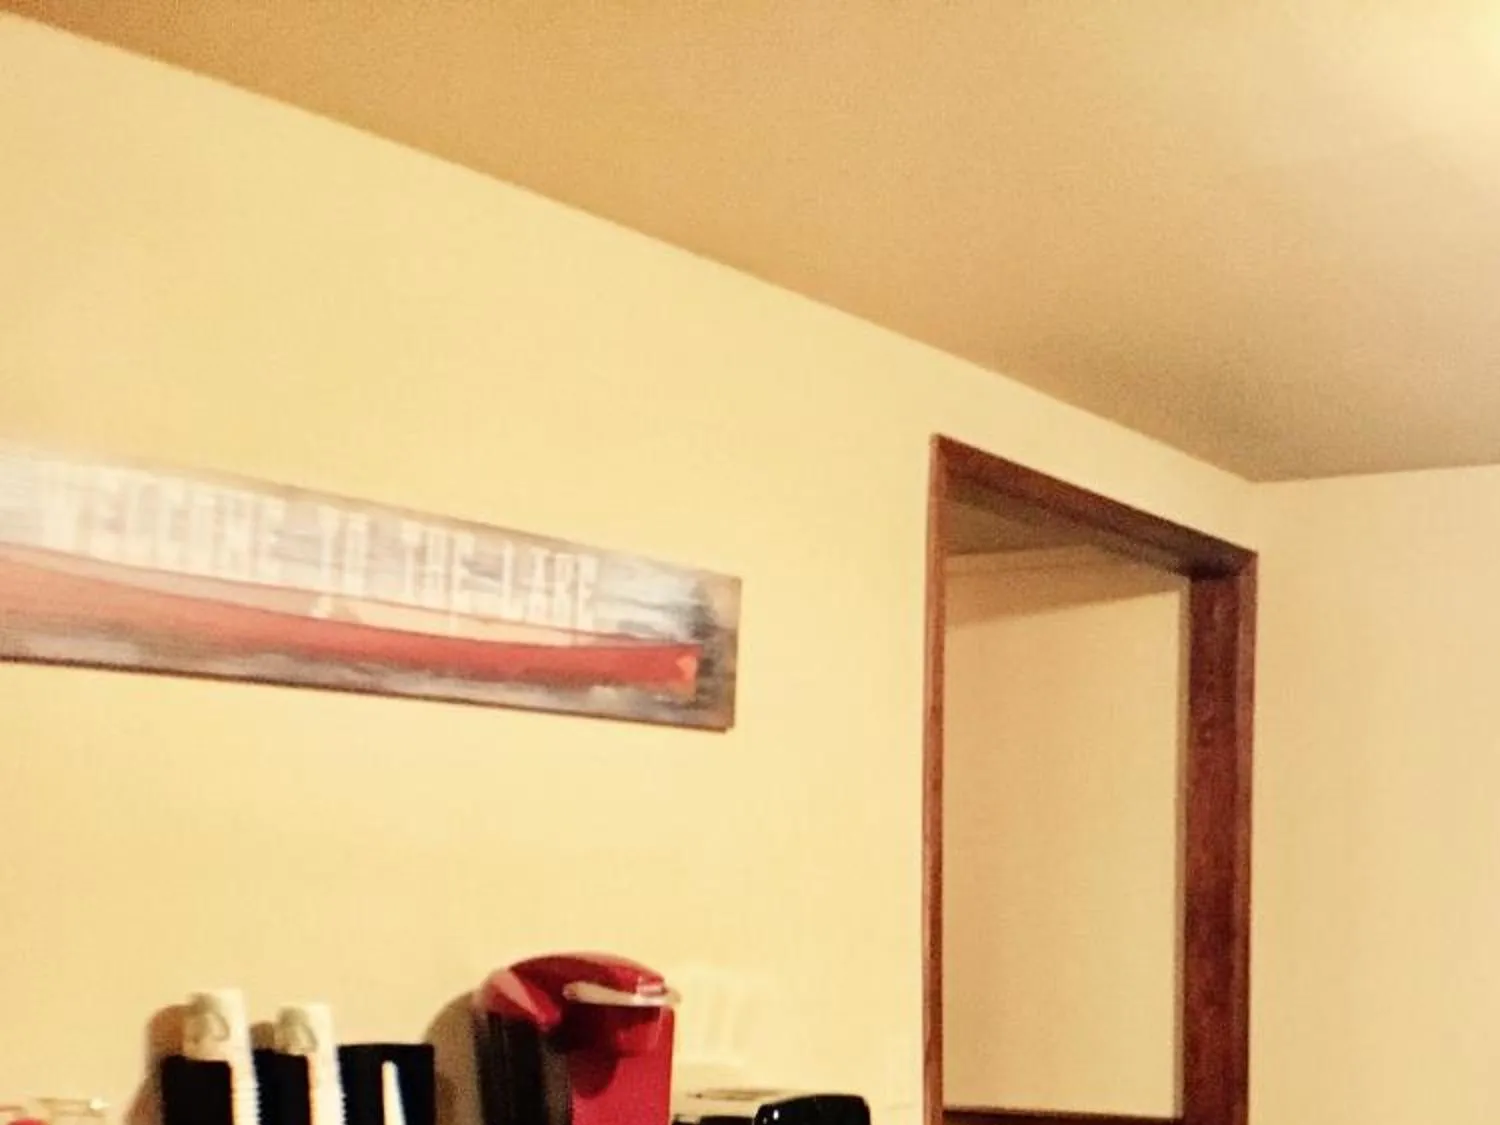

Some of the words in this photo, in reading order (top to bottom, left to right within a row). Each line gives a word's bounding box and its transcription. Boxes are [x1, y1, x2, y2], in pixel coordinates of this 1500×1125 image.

[316, 505, 370, 600] TO
[401, 519, 475, 614] THE
[502, 540, 598, 632] LAKE
